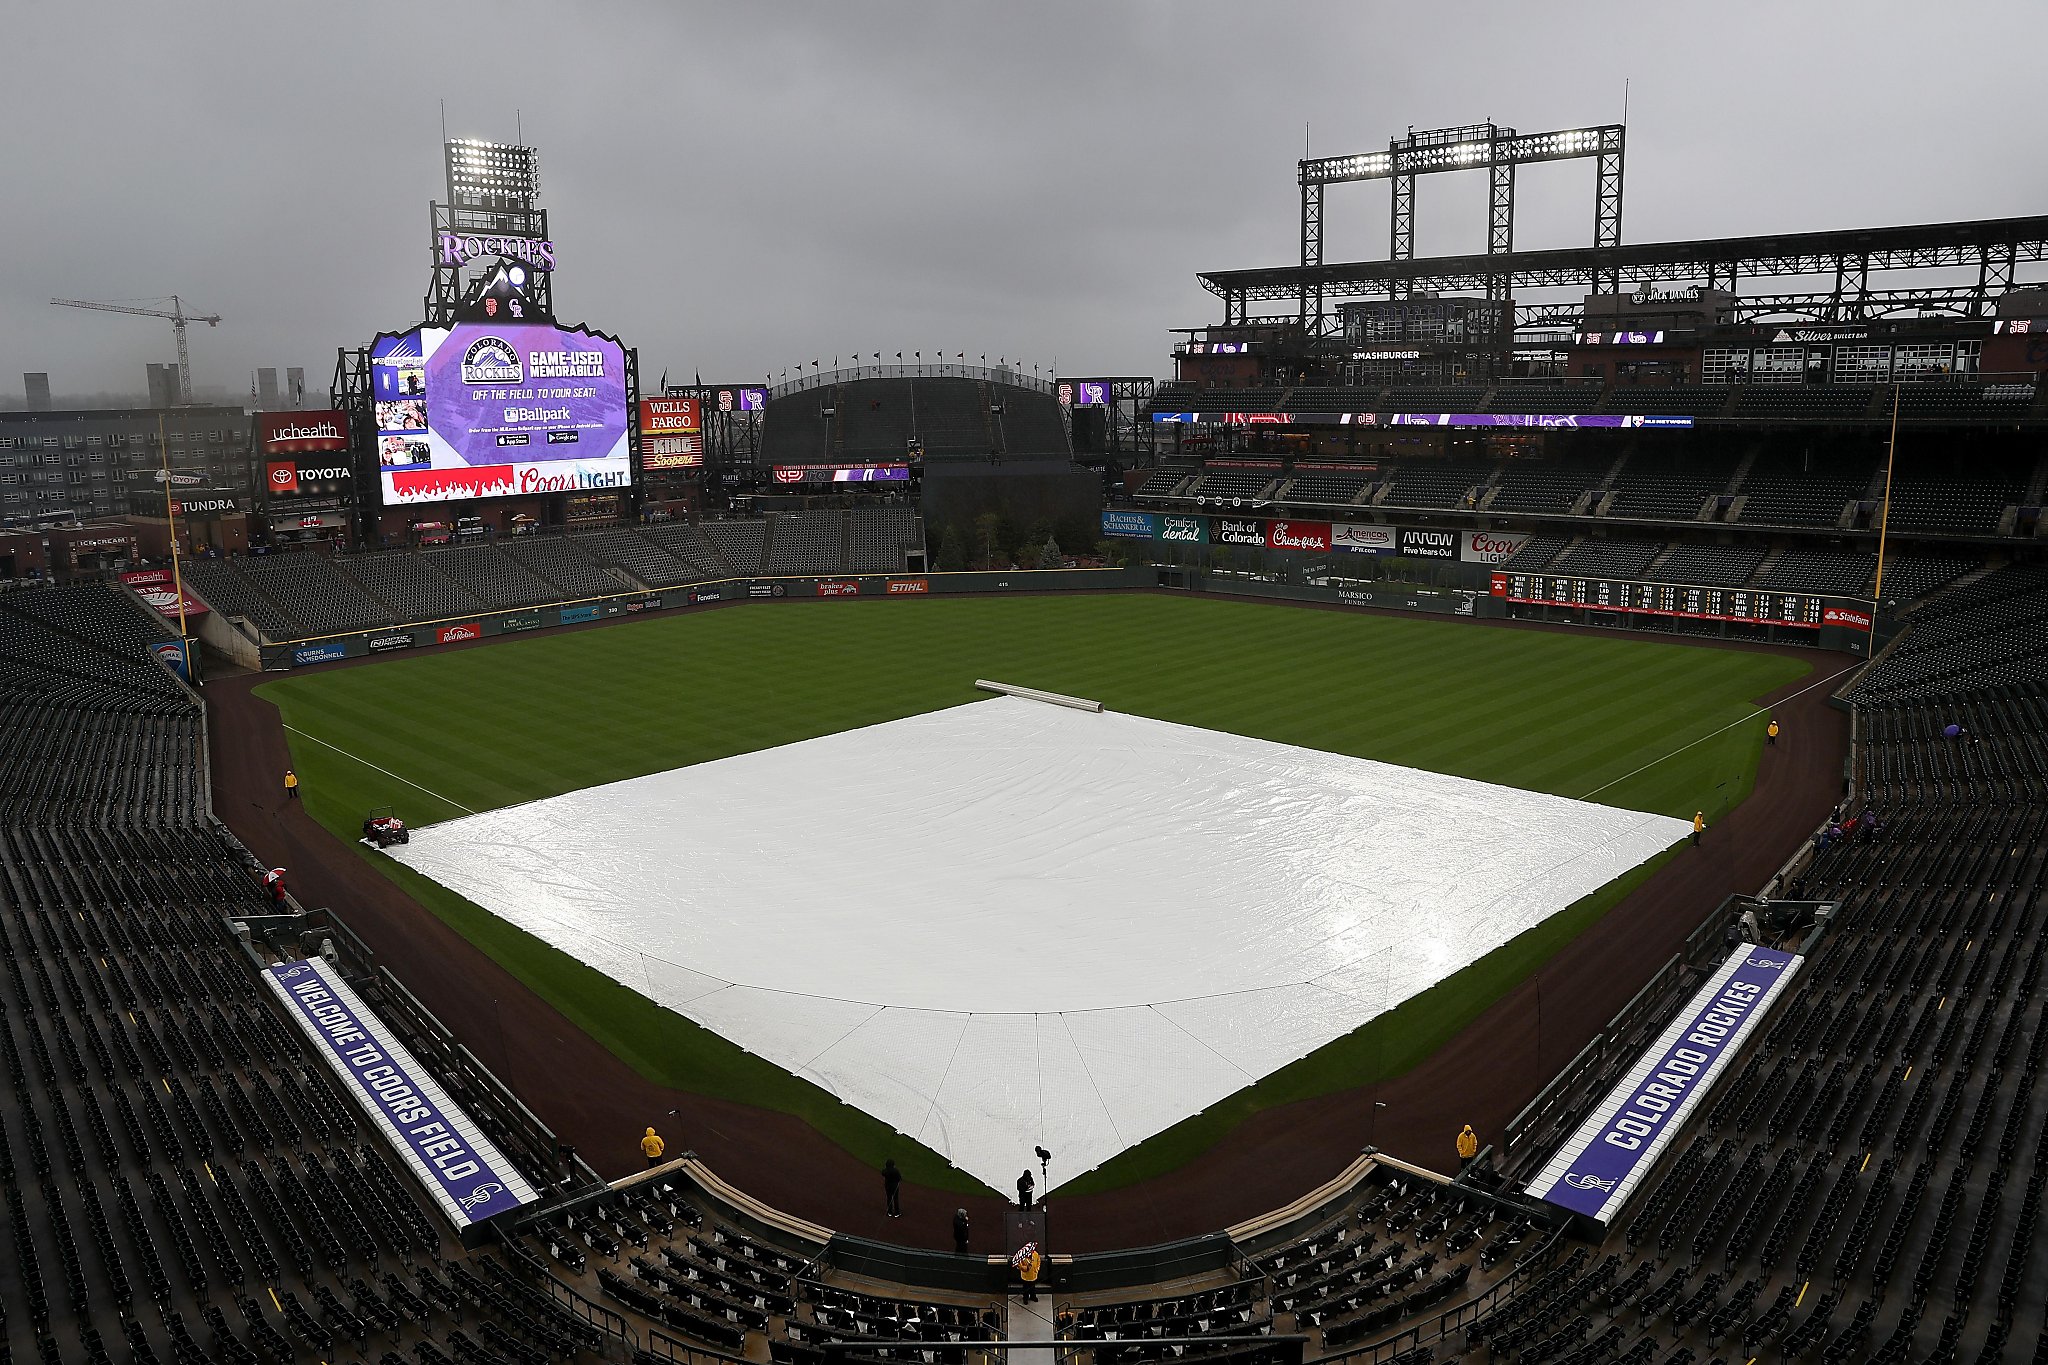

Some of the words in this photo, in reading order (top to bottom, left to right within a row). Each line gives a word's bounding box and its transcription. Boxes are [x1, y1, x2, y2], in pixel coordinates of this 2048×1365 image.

[440, 235, 556, 271] ROCKIES
[1794, 330, 1832, 341] Silver
[467, 338, 516, 360] COLORADO
[1352, 351, 1419, 359] SMASHBURGER
[530, 352, 603, 365] GAME-USED
[464, 366, 520, 379] ROCKIES
[530, 366, 604, 378] MEMORABILIA
[473, 390, 489, 400] OFF
[491, 390, 507, 400] THE
[538, 389, 548, 398] TO
[550, 388, 571, 398] YOUR
[573, 388, 596, 398] SEAT!
[650, 401, 690, 414] WELLS
[519, 406, 570, 422] Ballpark
[652, 416, 691, 428] FARGO
[273, 421, 338, 440] uchealth
[653, 438, 692, 454] KING
[297, 468, 351, 480] TOYOTA
[520, 468, 576, 493] Coors
[579, 471, 625, 488] LIGHT
[182, 499, 234, 513] TUNDRA
[1110, 514, 1137, 523] BACHUS
[1164, 517, 1197, 528] Comfort
[1104, 521, 1139, 530] SCHANKER
[1222, 521, 1244, 532] Bank
[1248, 522, 1256, 532] of
[1163, 528, 1199, 541] dental
[1222, 532, 1264, 544] Colorado
[1273, 528, 1324, 549] Chick-fil-A
[1419, 547, 1438, 556] Years
[1481, 552, 1508, 562] LIGH
[127, 572, 163, 583] uchealth
[697, 593, 719, 601] Fanatics
[1338, 591, 1372, 600] MARSICO
[443, 632, 456, 642] Red
[456, 631, 475, 640] Robin
[1605, 1049, 1708, 1151] COLORADO
[1688, 980, 1761, 1049] ROCKIES
[292, 978, 365, 1046] WELCOME
[346, 1042, 381, 1067] TO
[364, 1065, 430, 1125] COORS
[410, 1118, 480, 1182] FIELD
